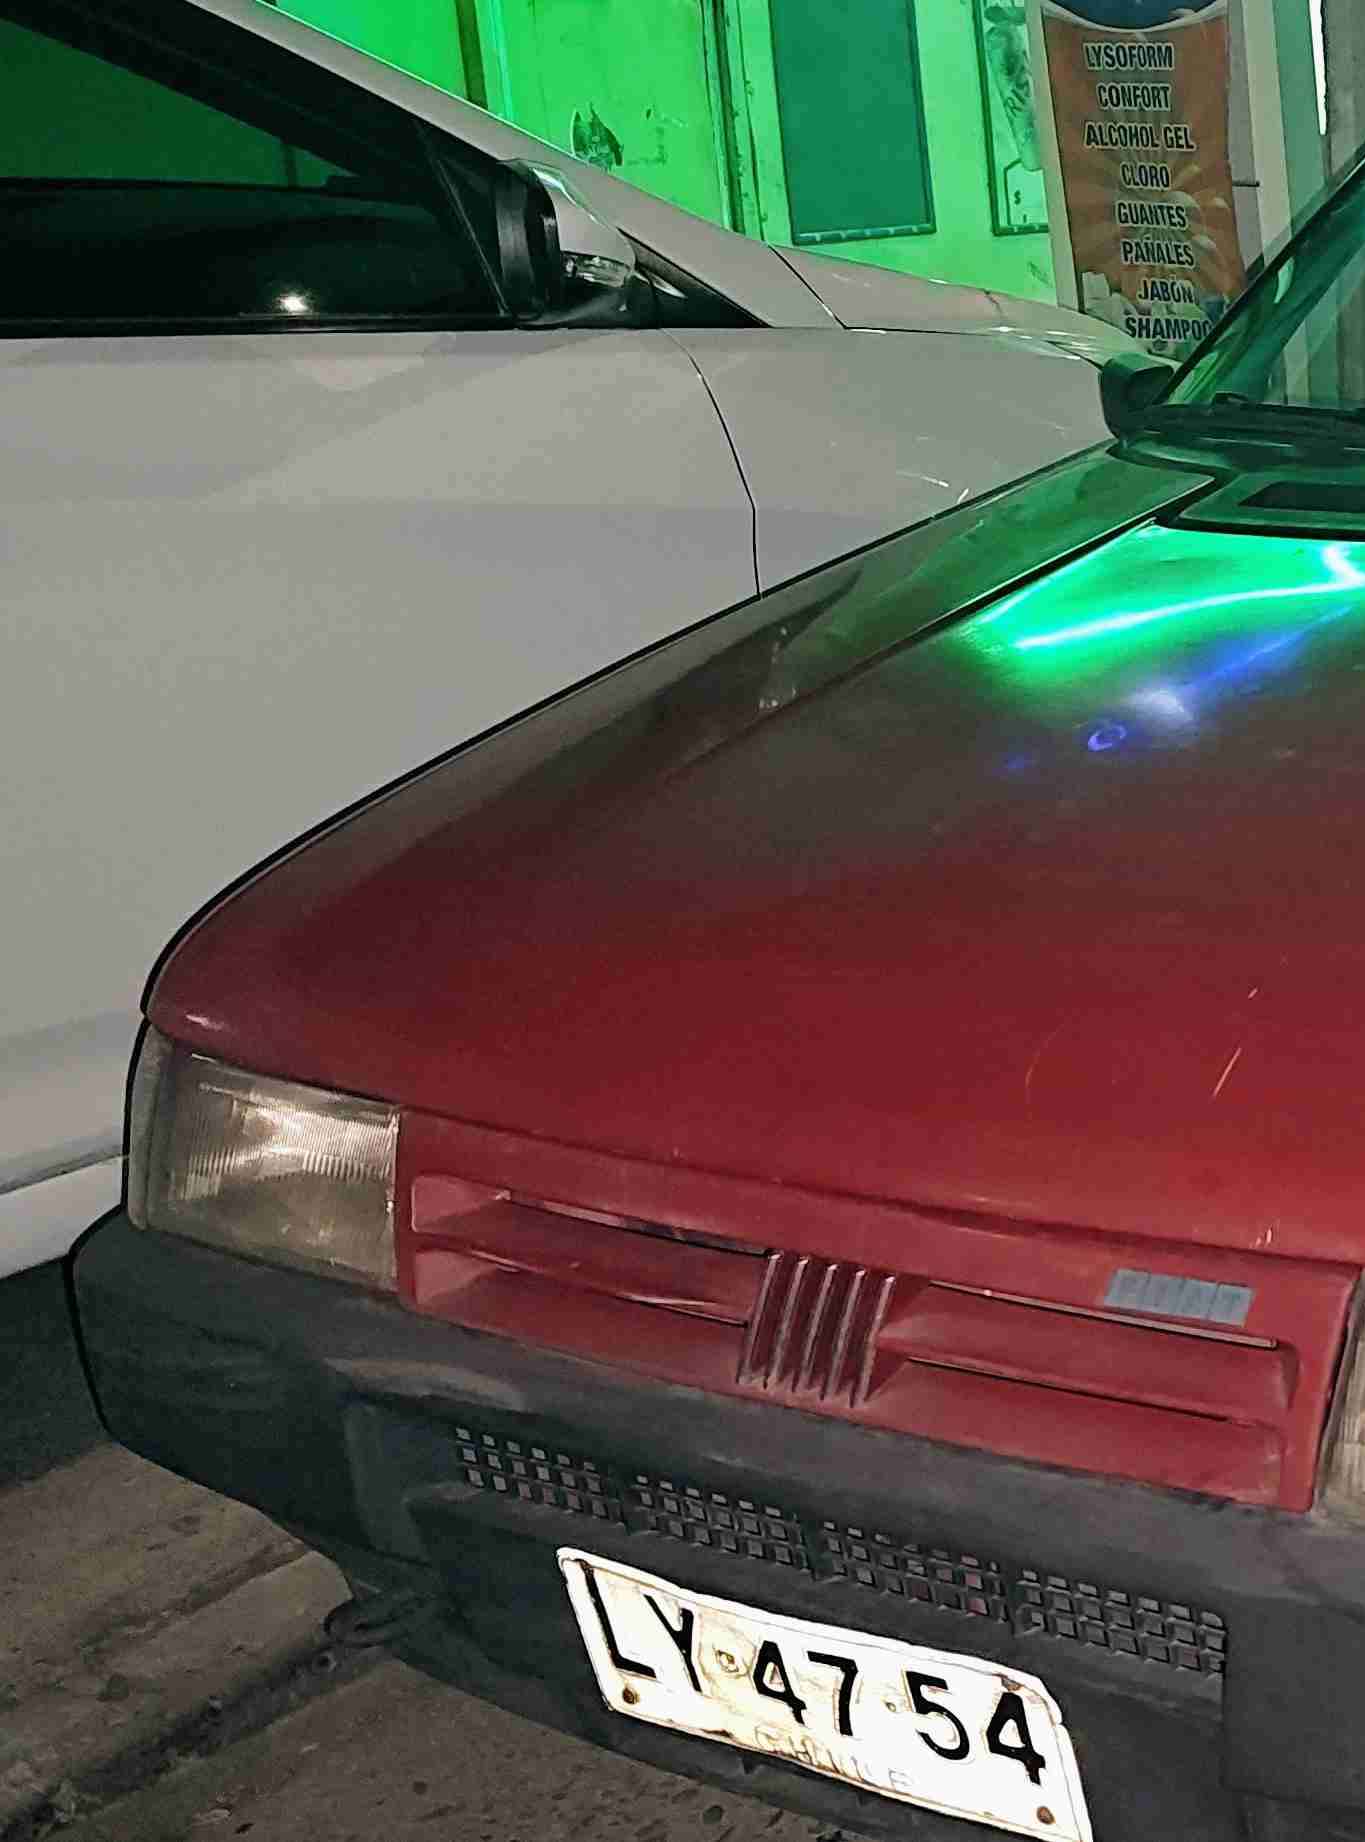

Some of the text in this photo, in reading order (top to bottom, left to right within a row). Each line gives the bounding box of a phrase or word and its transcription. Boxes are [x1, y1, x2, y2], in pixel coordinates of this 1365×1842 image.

[1084, 43, 1174, 69] LYSOFORM
[1097, 84, 1171, 109] CONFORT
[1085, 123, 1195, 150] ALCOHOL GEL
[1120, 163, 1170, 188] CLORO
[1117, 202, 1187, 228] GUANTES
[582, 1559, 1046, 1786] LY 47 54
